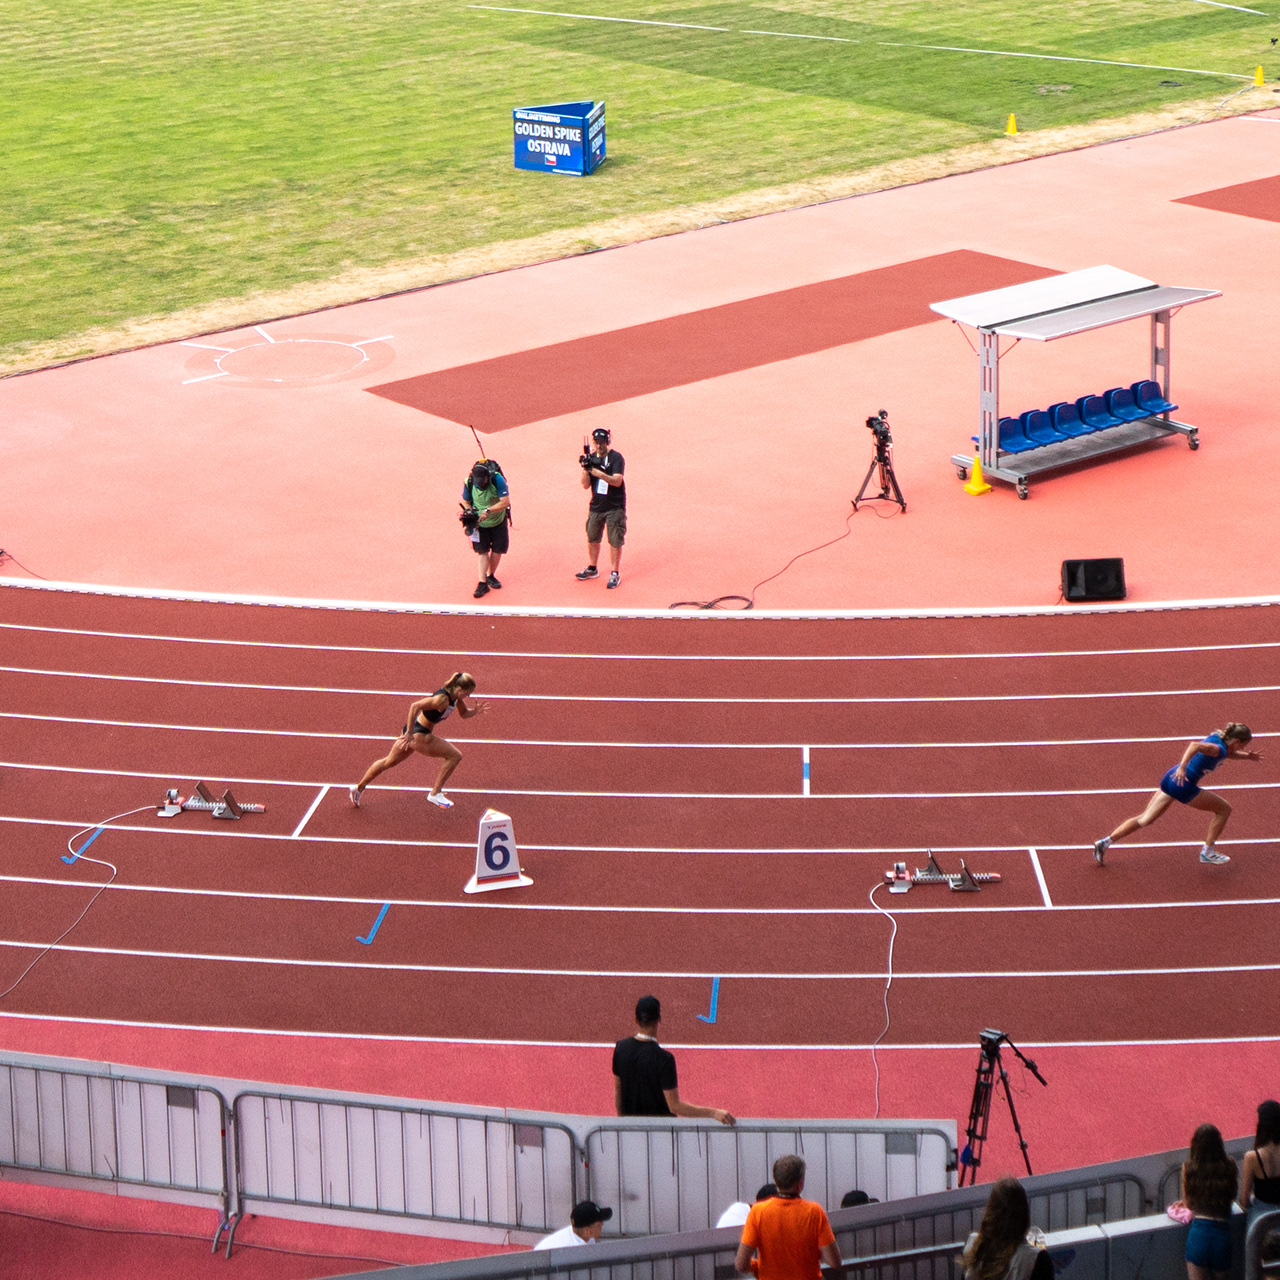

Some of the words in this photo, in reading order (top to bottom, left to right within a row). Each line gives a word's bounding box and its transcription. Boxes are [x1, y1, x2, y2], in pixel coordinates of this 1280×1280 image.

[515, 122, 554, 140] GOLDEN
[554, 126, 581, 144] SPIKE
[527, 139, 571, 157] OSTRAVA
[484, 831, 511, 871] 6
